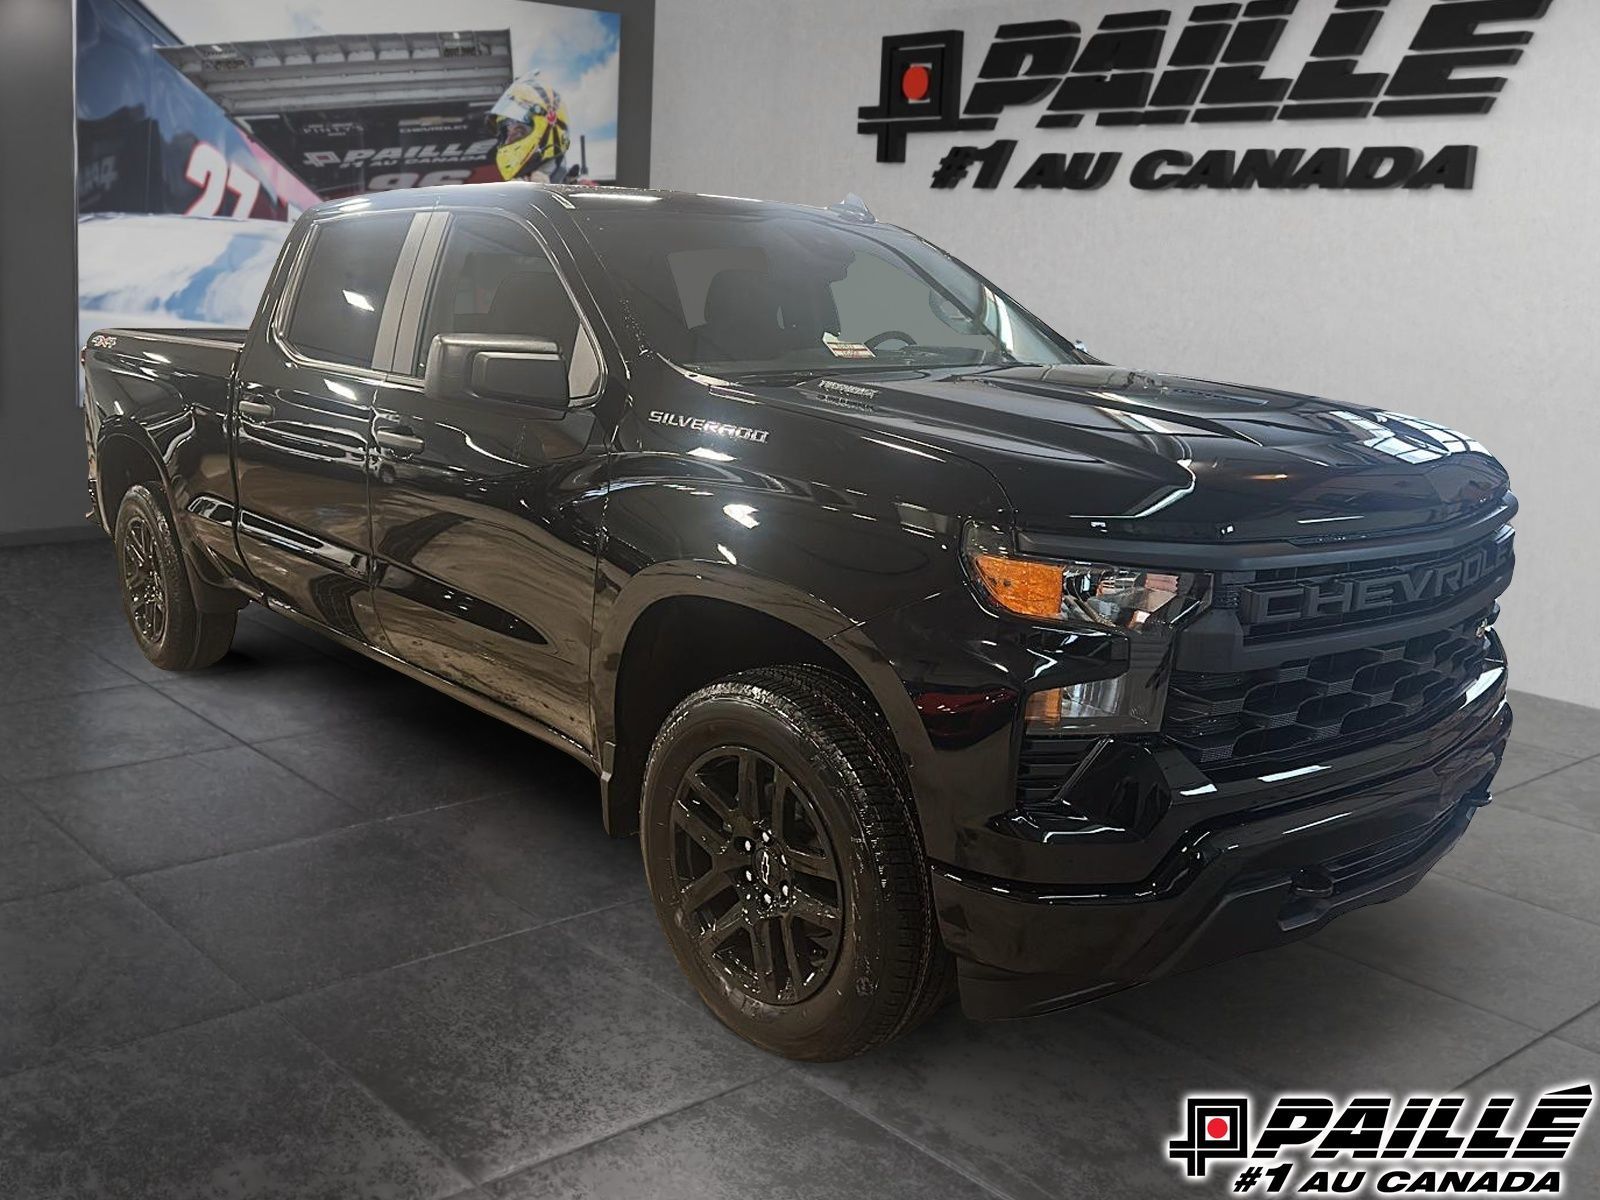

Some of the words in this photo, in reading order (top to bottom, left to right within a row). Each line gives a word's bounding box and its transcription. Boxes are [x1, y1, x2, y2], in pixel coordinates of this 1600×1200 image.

[400, 125, 468, 133] CHEVROLET
[405, 155, 487, 165] CANADA
[930, 139, 1018, 189] #1
[1014, 152, 1122, 190] AU
[1129, 145, 1478, 190] CANADA
[183, 141, 260, 219] 27
[648, 410, 770, 444] SILVERADO
